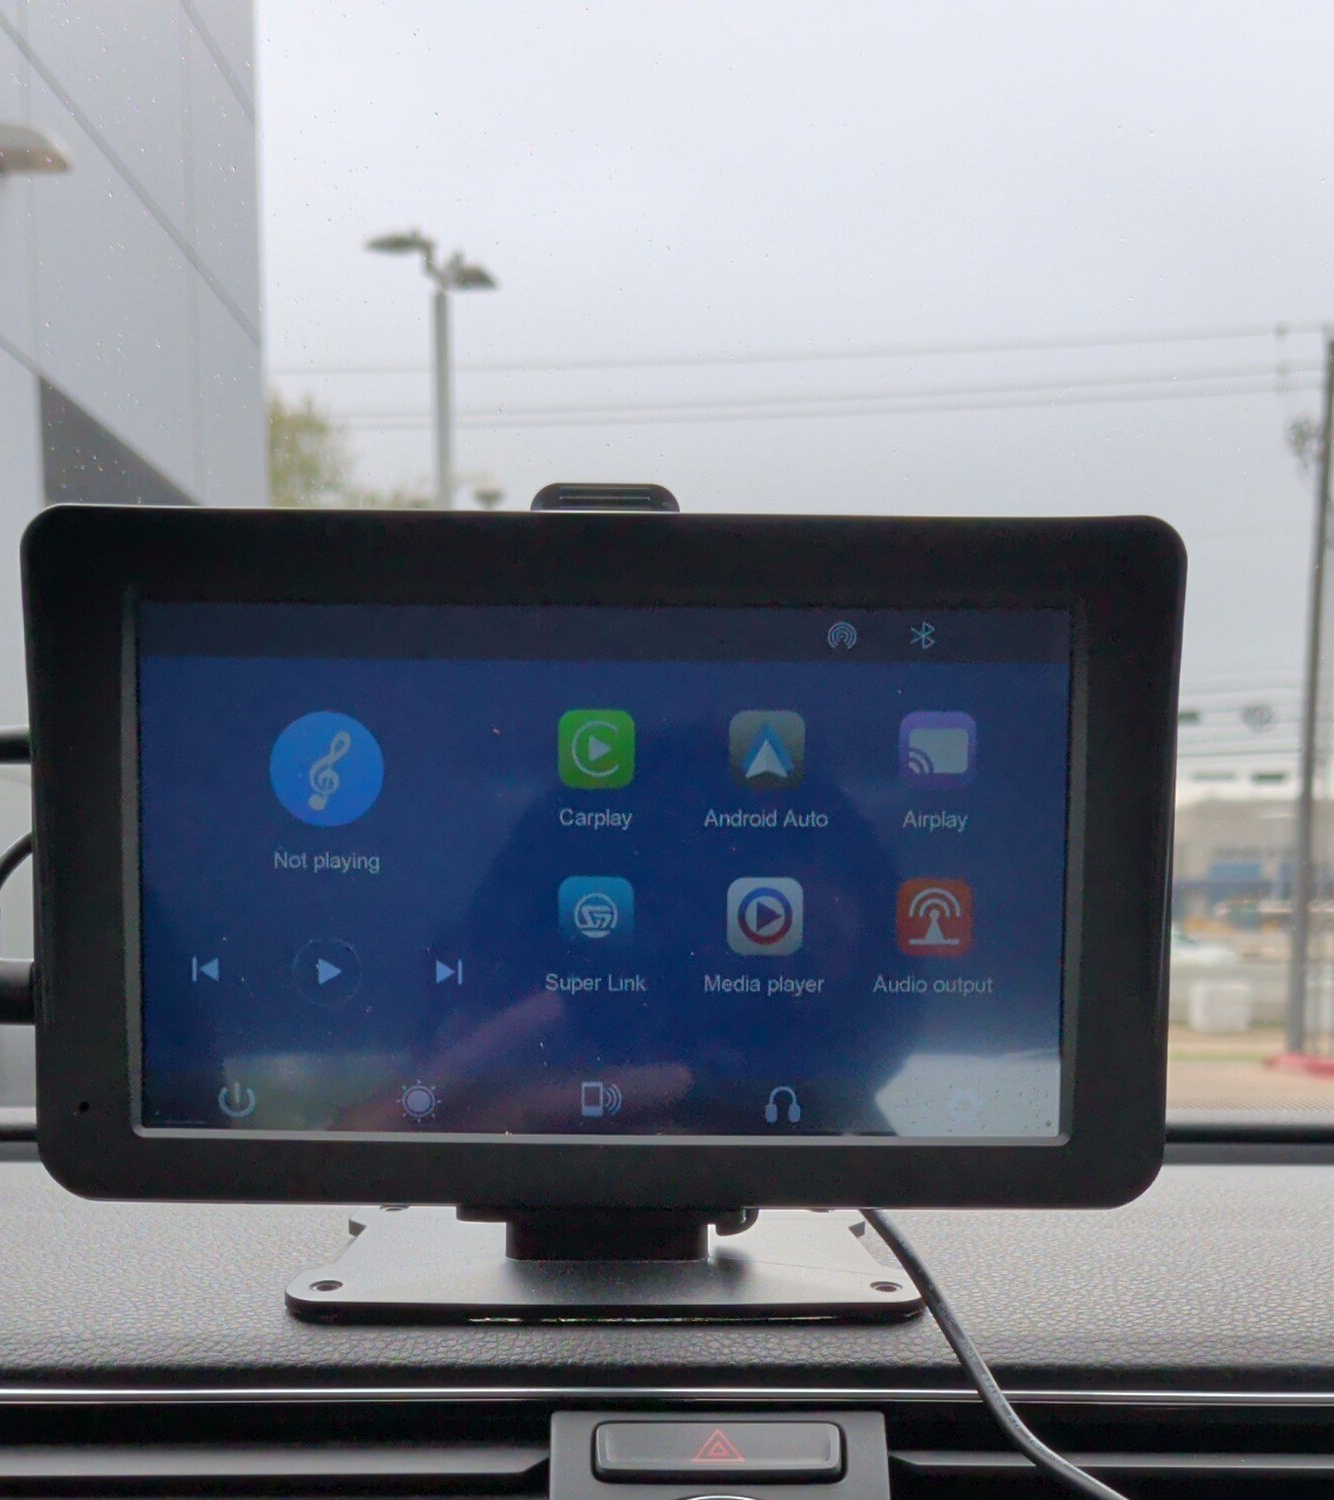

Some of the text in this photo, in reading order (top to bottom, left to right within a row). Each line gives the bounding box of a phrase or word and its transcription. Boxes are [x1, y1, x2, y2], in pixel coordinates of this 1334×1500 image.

[559, 808, 633, 831] Carplay
[704, 808, 829, 828] Android Auto
[902, 810, 968, 833] Airplay
[274, 851, 381, 874] Not playing
[545, 973, 647, 995] Super Link
[704, 974, 825, 996] Media player
[872, 975, 993, 996] Audio output
